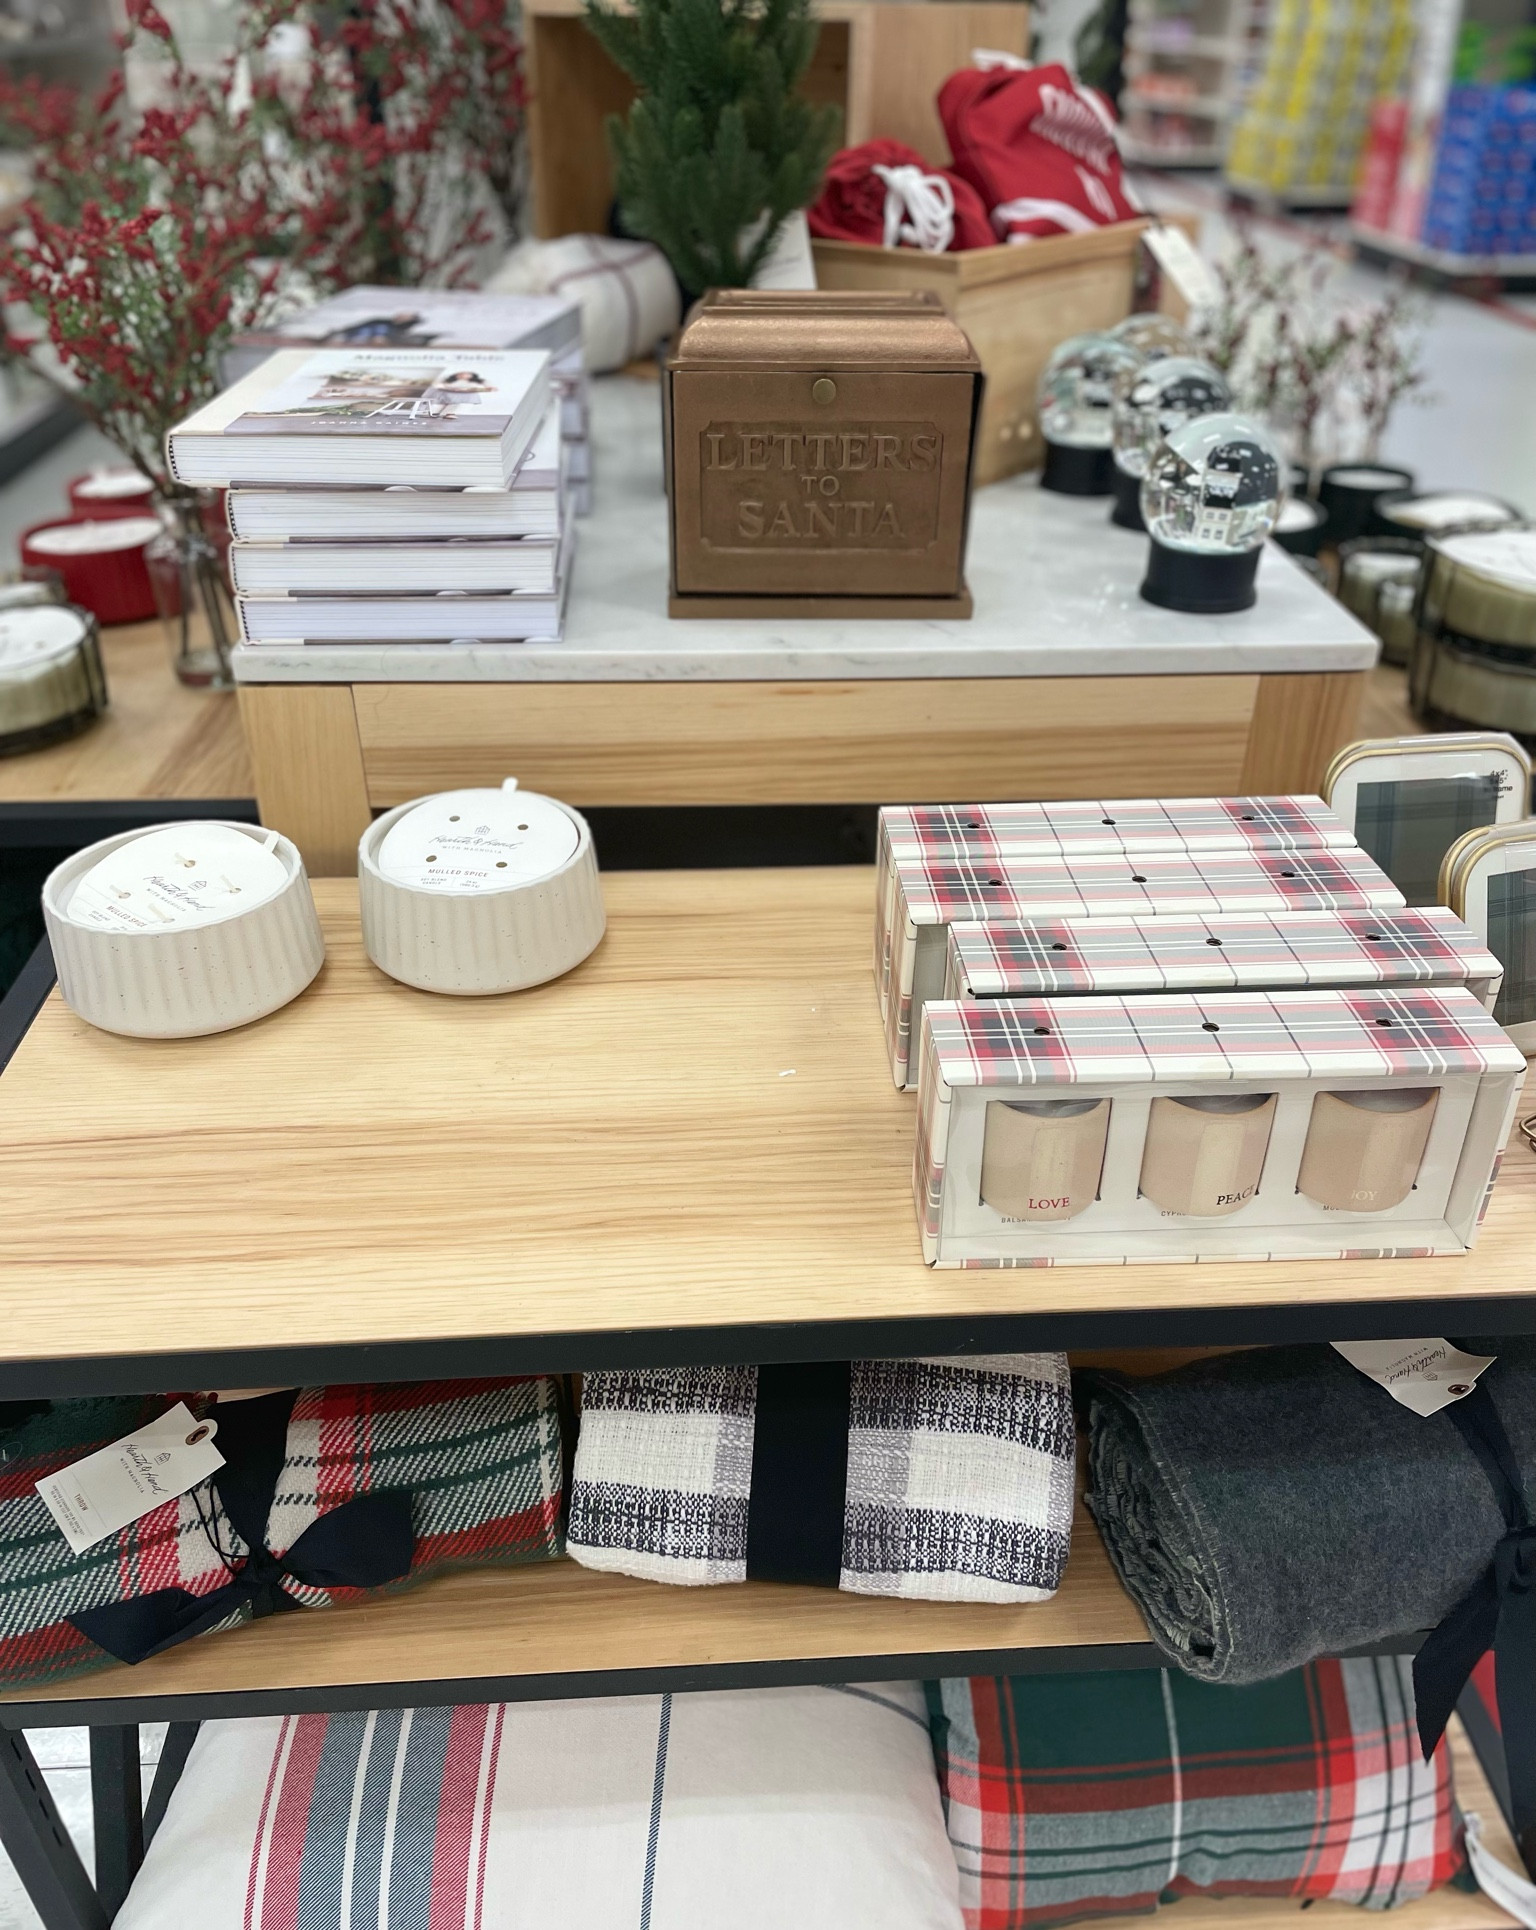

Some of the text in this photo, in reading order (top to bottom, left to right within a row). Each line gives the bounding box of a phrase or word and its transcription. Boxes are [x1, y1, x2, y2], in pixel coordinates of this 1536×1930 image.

[706, 433, 937, 472] LETTERS
[801, 474, 840, 497] TO
[737, 501, 906, 539] SANTA
[106, 905, 131, 920] MULLED
[128, 917, 148, 928] SPICE
[1028, 1197, 1070, 1210] LOVE
[1384, 1365, 1411, 1385] Hand
[74, 1493, 89, 1511] THROW
